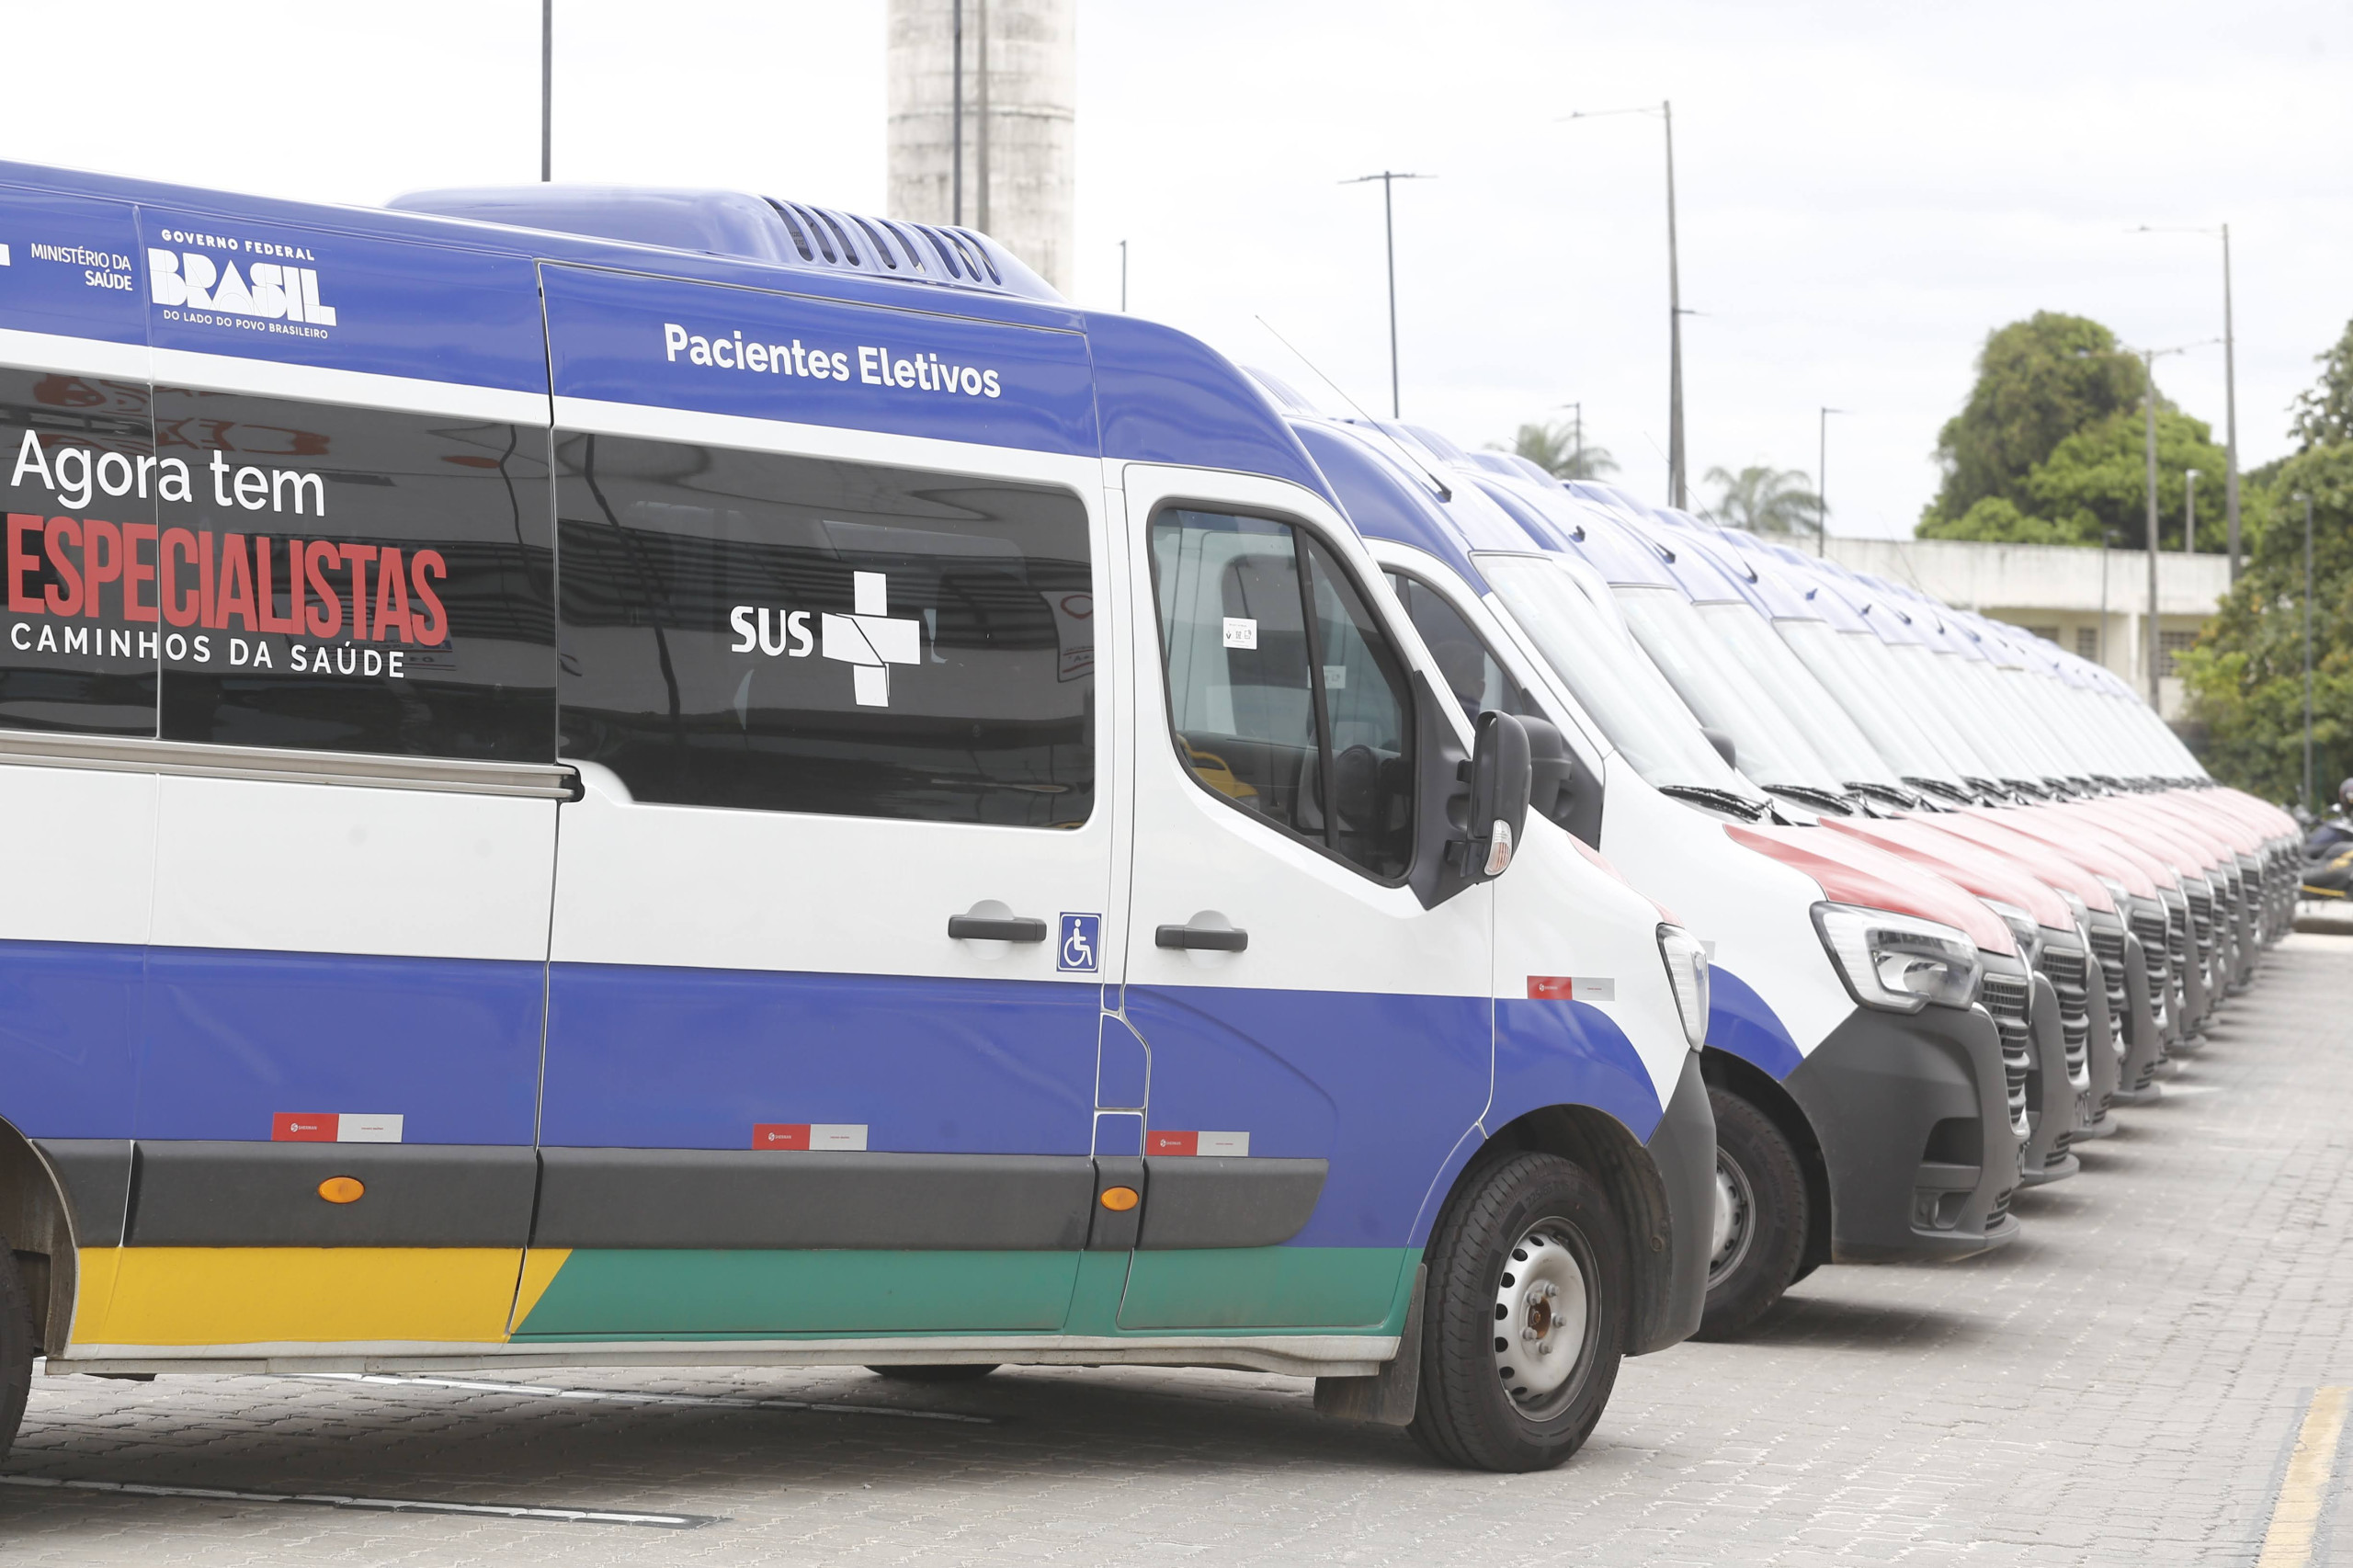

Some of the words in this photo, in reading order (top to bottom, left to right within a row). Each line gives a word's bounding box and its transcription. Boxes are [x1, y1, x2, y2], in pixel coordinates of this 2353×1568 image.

[30, 243, 109, 268] MINISTÉRIO
[112, 254, 132, 271] DA
[161, 229, 238, 250] GOVERNO
[244, 240, 315, 261] FEDERAL
[85, 268, 133, 290] SAÚDE
[147, 247, 336, 326] BRASIL
[164, 309, 180, 321] DO
[183, 312, 212, 324] LADO
[216, 316, 233, 327] DO
[235, 318, 266, 331] POVO
[268, 323, 328, 339] BRASILEIRO
[664, 323, 850, 381] Pacientes
[858, 346, 1001, 398] Eletivos
[10, 429, 193, 510] Agora
[209, 449, 325, 517] tem
[6, 513, 448, 646] ESPECIALISTAS
[10, 622, 210, 663] CAMINHOS
[230, 638, 273, 669] DA
[290, 641, 404, 678] SAÚDE
[730, 606, 813, 658] SUS
